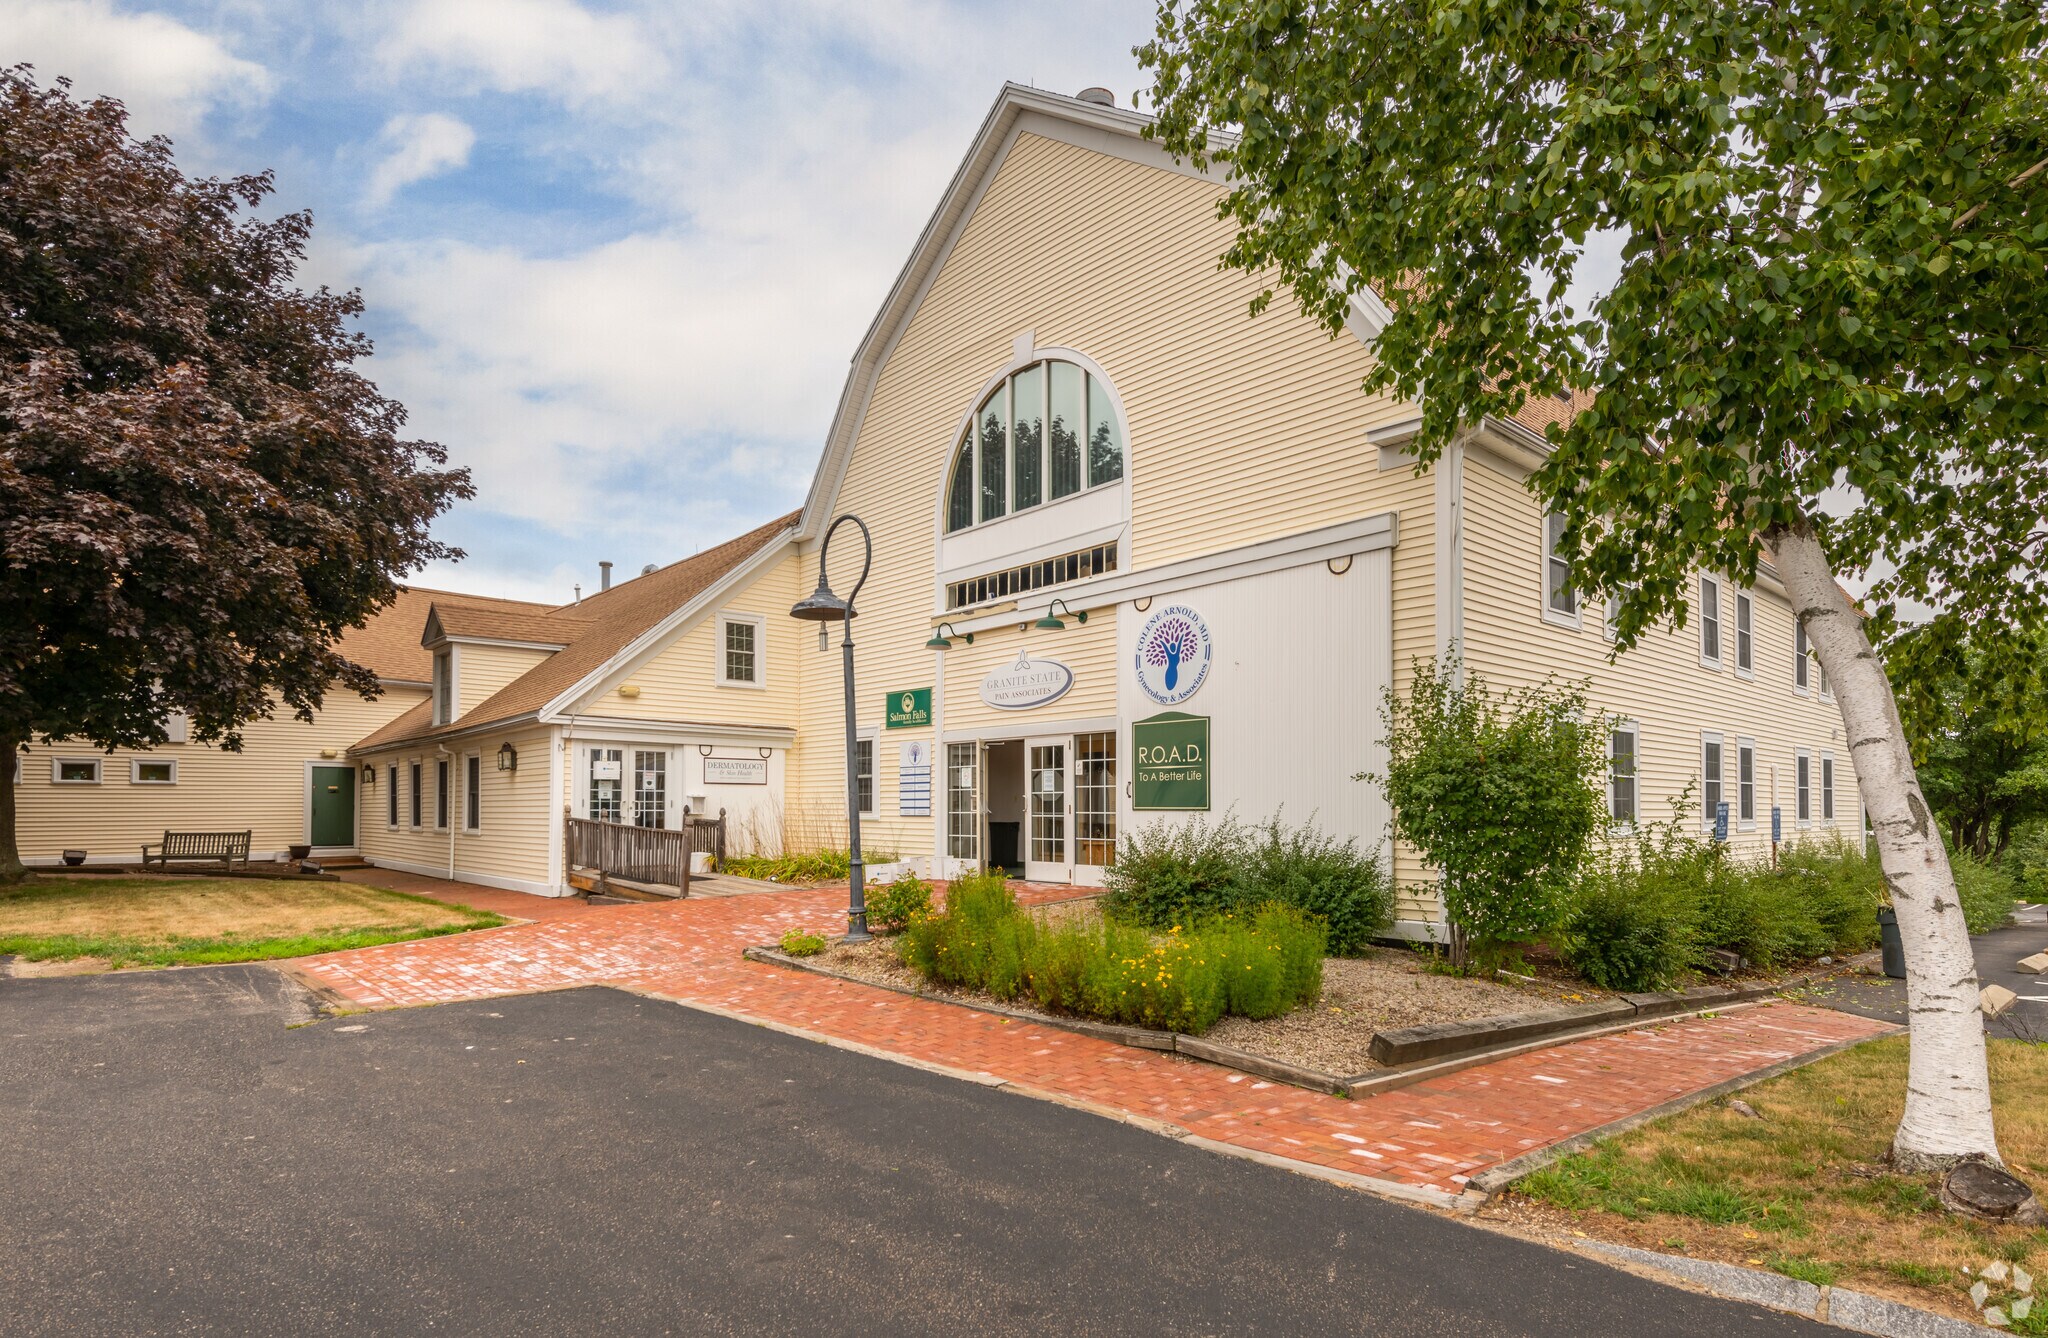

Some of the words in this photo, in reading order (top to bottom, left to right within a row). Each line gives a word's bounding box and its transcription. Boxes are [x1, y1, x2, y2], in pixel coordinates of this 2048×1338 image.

[1137, 612, 1162, 651] COLENE
[1163, 606, 1199, 625] ARNOLD,
[1198, 623, 1209, 642] MD
[986, 674, 1028, 689] GRANITE
[1029, 671, 1062, 682] STATE
[1137, 670, 1168, 704] Gynecology
[1169, 694, 1177, 703] &
[1177, 663, 1207, 700] Associates
[994, 692, 1009, 700] PAIN
[1010, 687, 1052, 699] ASSOCIATES
[889, 712, 912, 722] Salmon
[912, 709, 927, 719] Falls
[1138, 744, 1203, 764] R.O.A.D.
[707, 761, 765, 770] DERMATOLOGY
[1138, 772, 1149, 782] To
[1150, 772, 1157, 782] A
[1159, 771, 1185, 782] Better
[1186, 770, 1202, 781] Life
